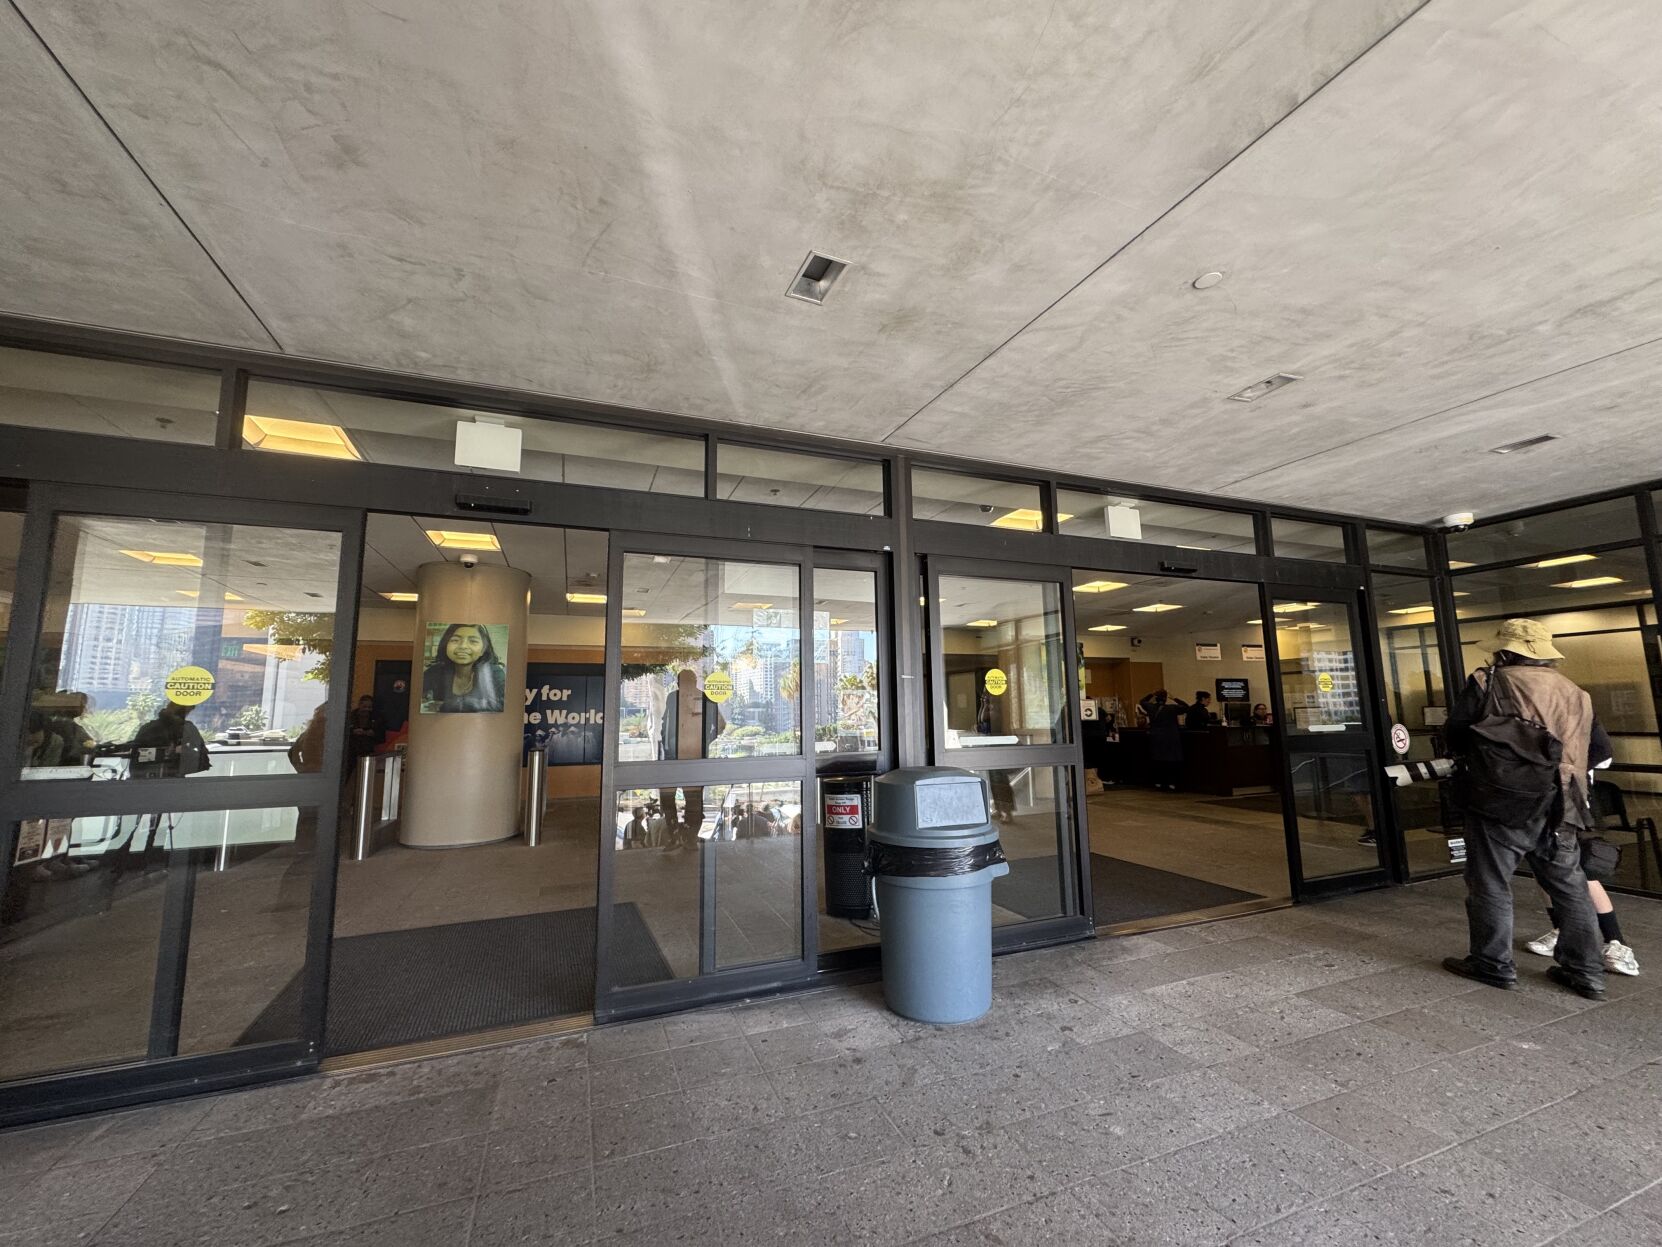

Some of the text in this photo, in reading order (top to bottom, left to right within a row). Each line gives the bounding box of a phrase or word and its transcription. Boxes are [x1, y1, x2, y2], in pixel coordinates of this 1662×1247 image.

[166, 682, 212, 690] CAUTION
[541, 684, 572, 701] for
[831, 805, 851, 814] ONLY
